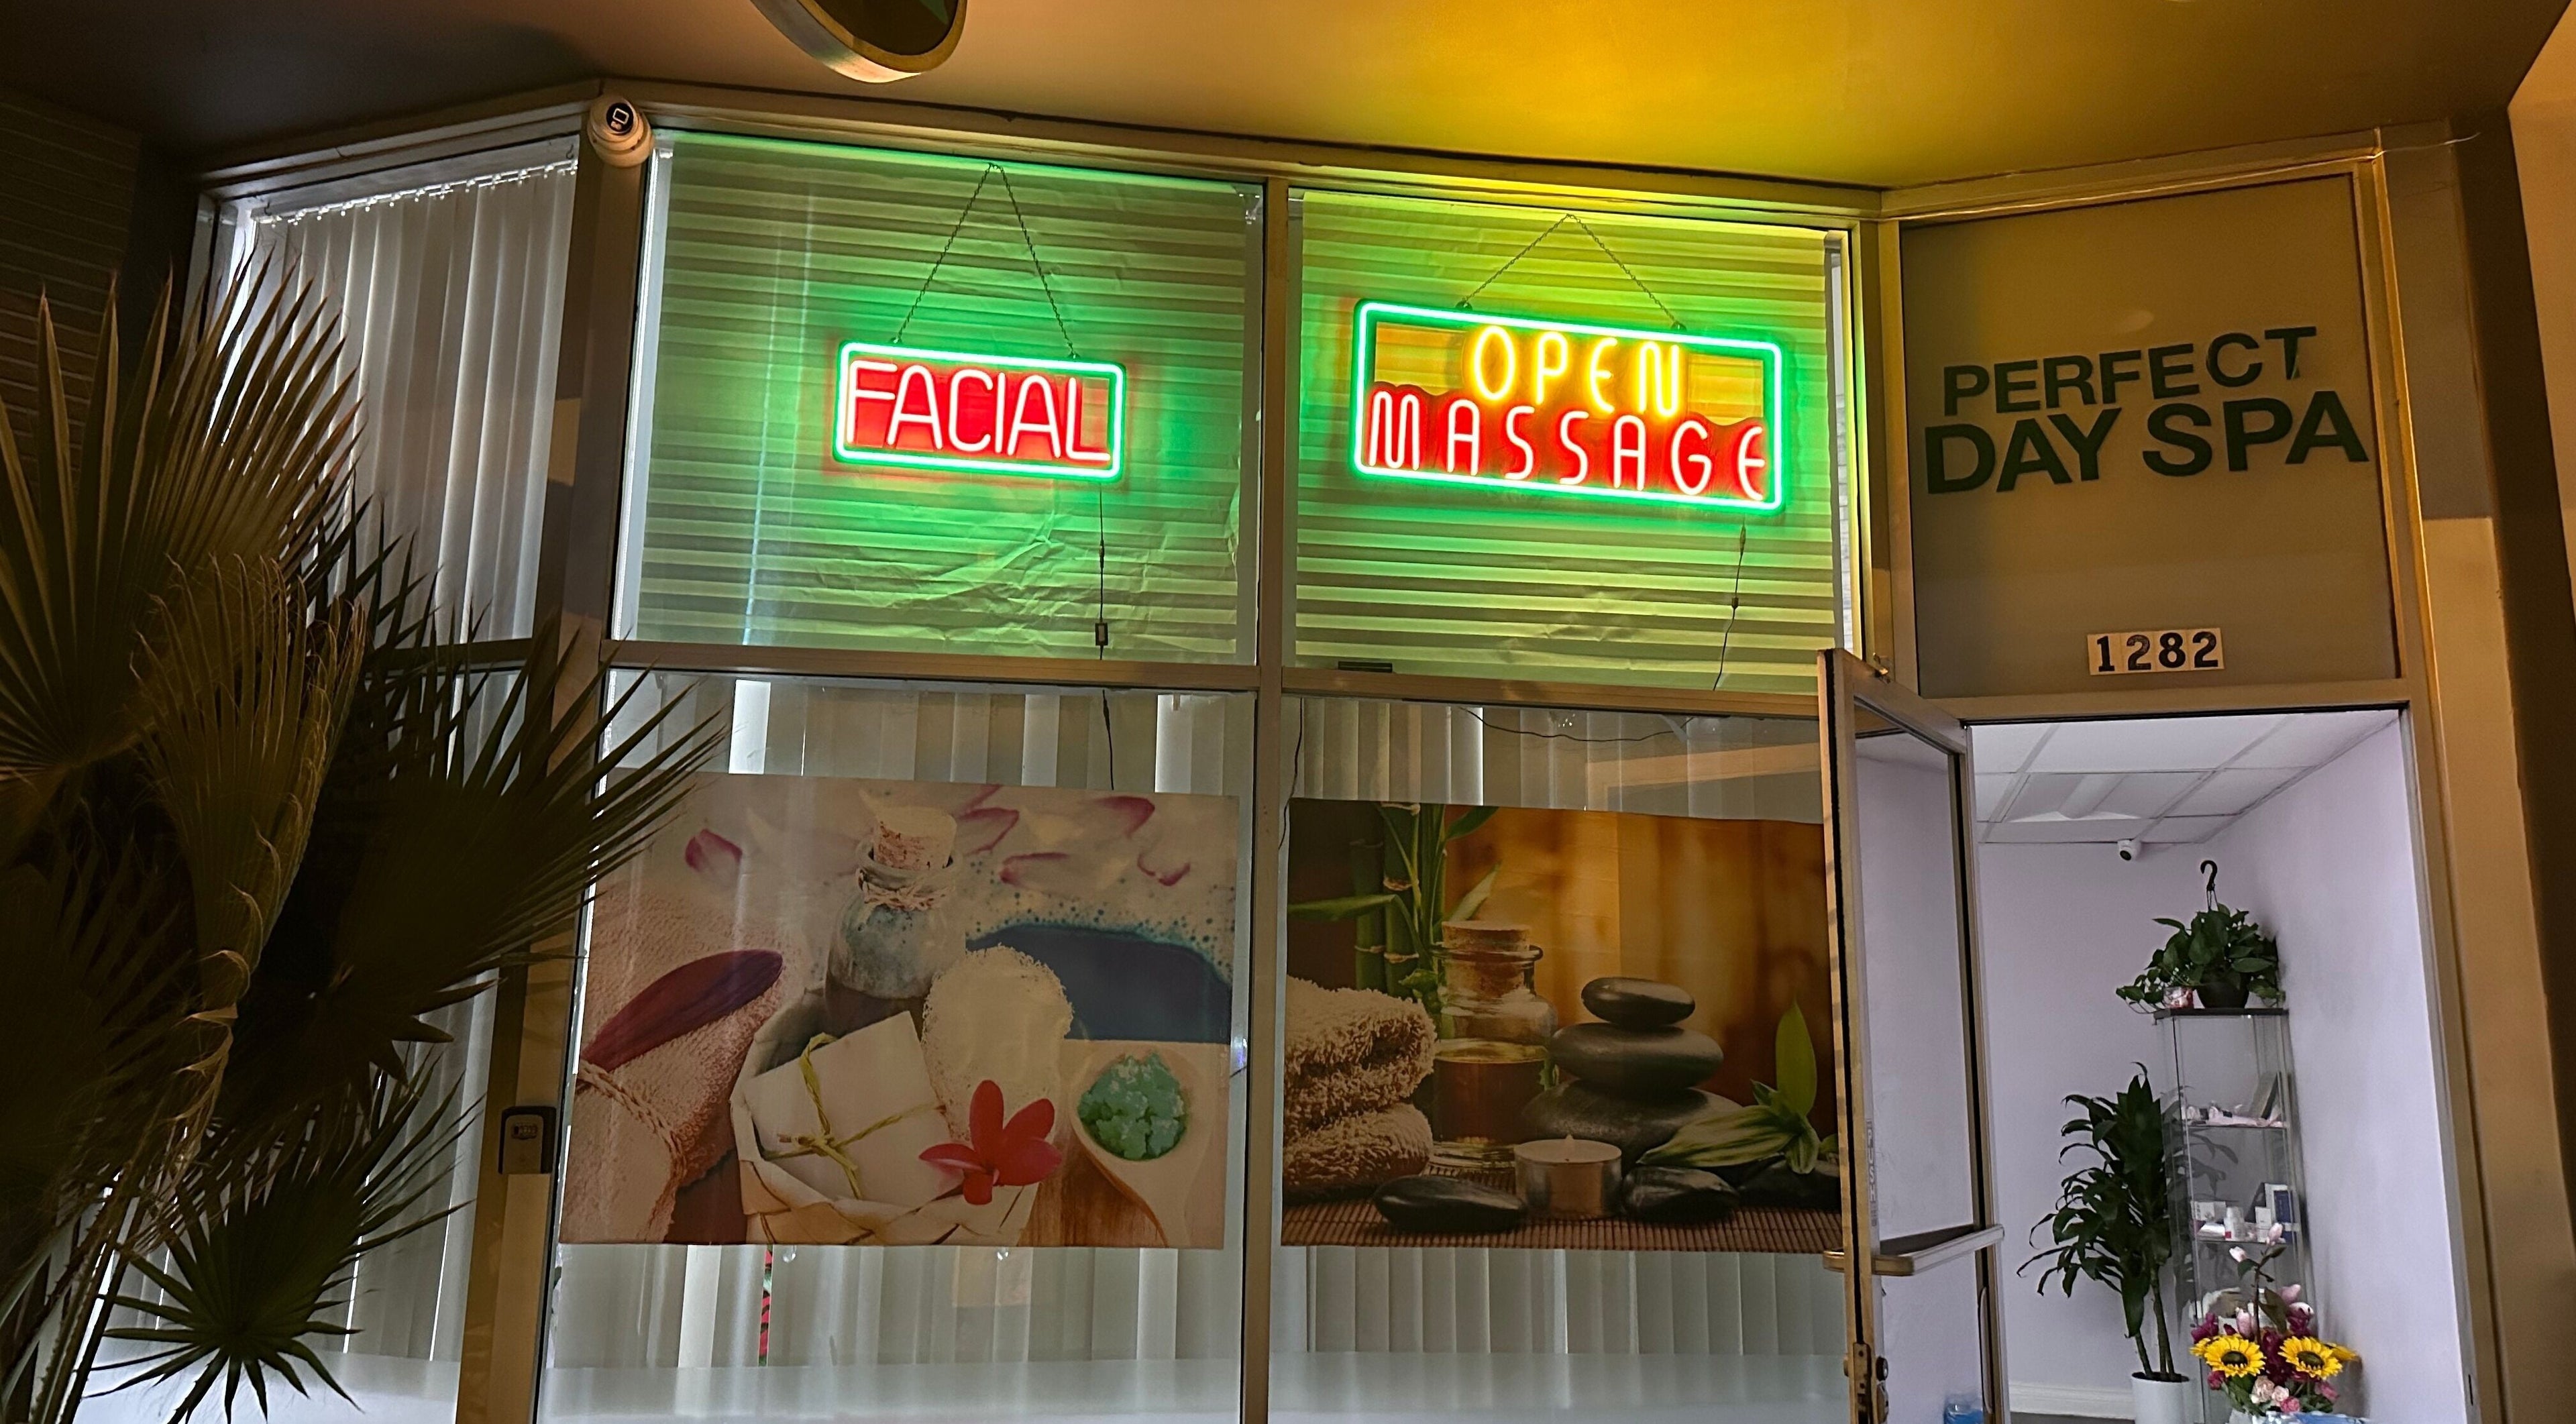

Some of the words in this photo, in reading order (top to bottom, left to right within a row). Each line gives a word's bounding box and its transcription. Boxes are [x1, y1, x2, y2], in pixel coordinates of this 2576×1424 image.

[847, 360, 1111, 461] FACIAL
[1472, 325, 1680, 418] OPEN
[1943, 325, 2317, 417] PERFECT
[1368, 390, 1766, 501] MASSAGE
[1924, 406, 2123, 494] DAY
[2142, 390, 2370, 477] SPA
[2096, 631, 2218, 672] 1282
[1867, 1128, 1876, 1202] PUSH
